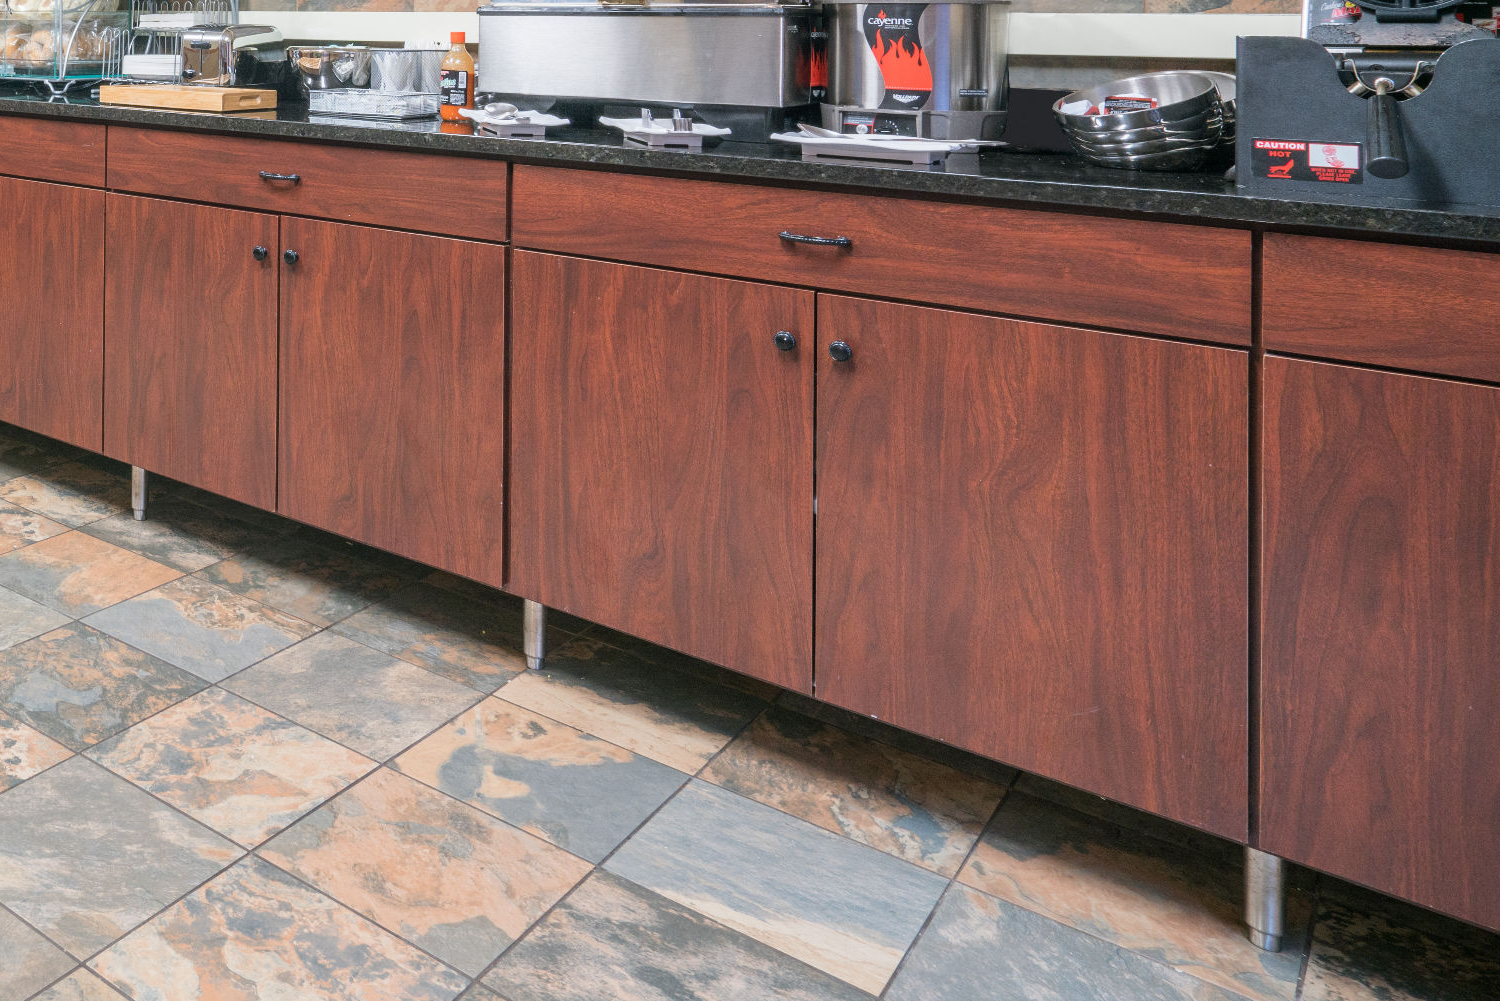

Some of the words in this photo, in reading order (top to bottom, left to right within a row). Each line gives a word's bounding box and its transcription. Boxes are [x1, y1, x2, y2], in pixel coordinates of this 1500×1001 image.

[867, 17, 913, 27] cayenne
[1256, 141, 1305, 150] CAUTION
[1268, 150, 1292, 158] HOT
